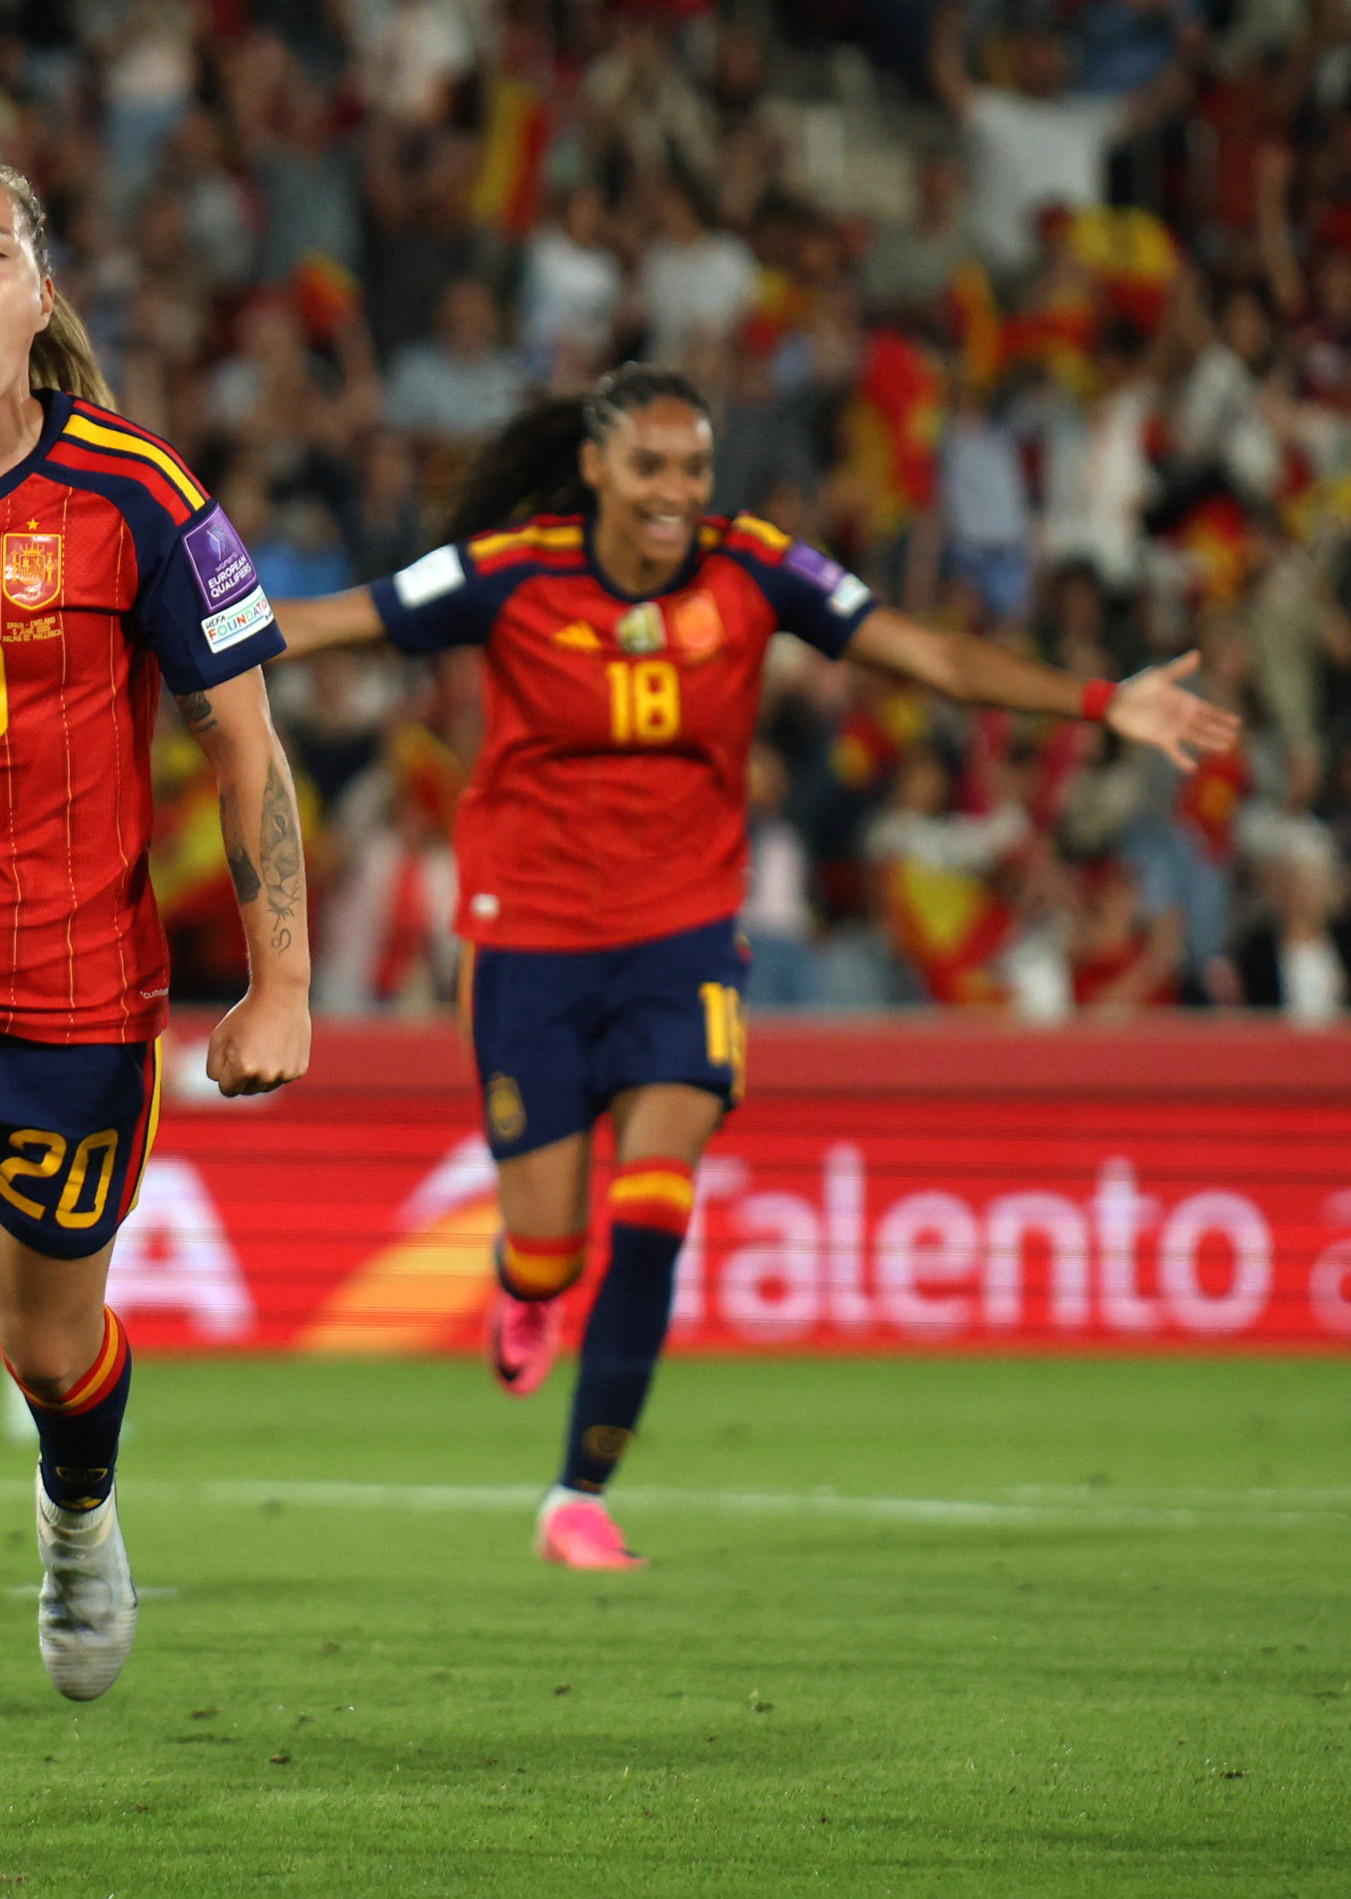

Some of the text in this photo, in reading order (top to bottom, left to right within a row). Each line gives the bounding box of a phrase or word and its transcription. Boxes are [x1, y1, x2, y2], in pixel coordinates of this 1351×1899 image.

[208, 554, 247, 589] EUROPEAN
[210, 562, 252, 598] QUALIFIERS
[205, 615, 226, 630] UEFA
[607, 660, 681, 742] 18
[670, 1141, 1275, 1343] Talento
